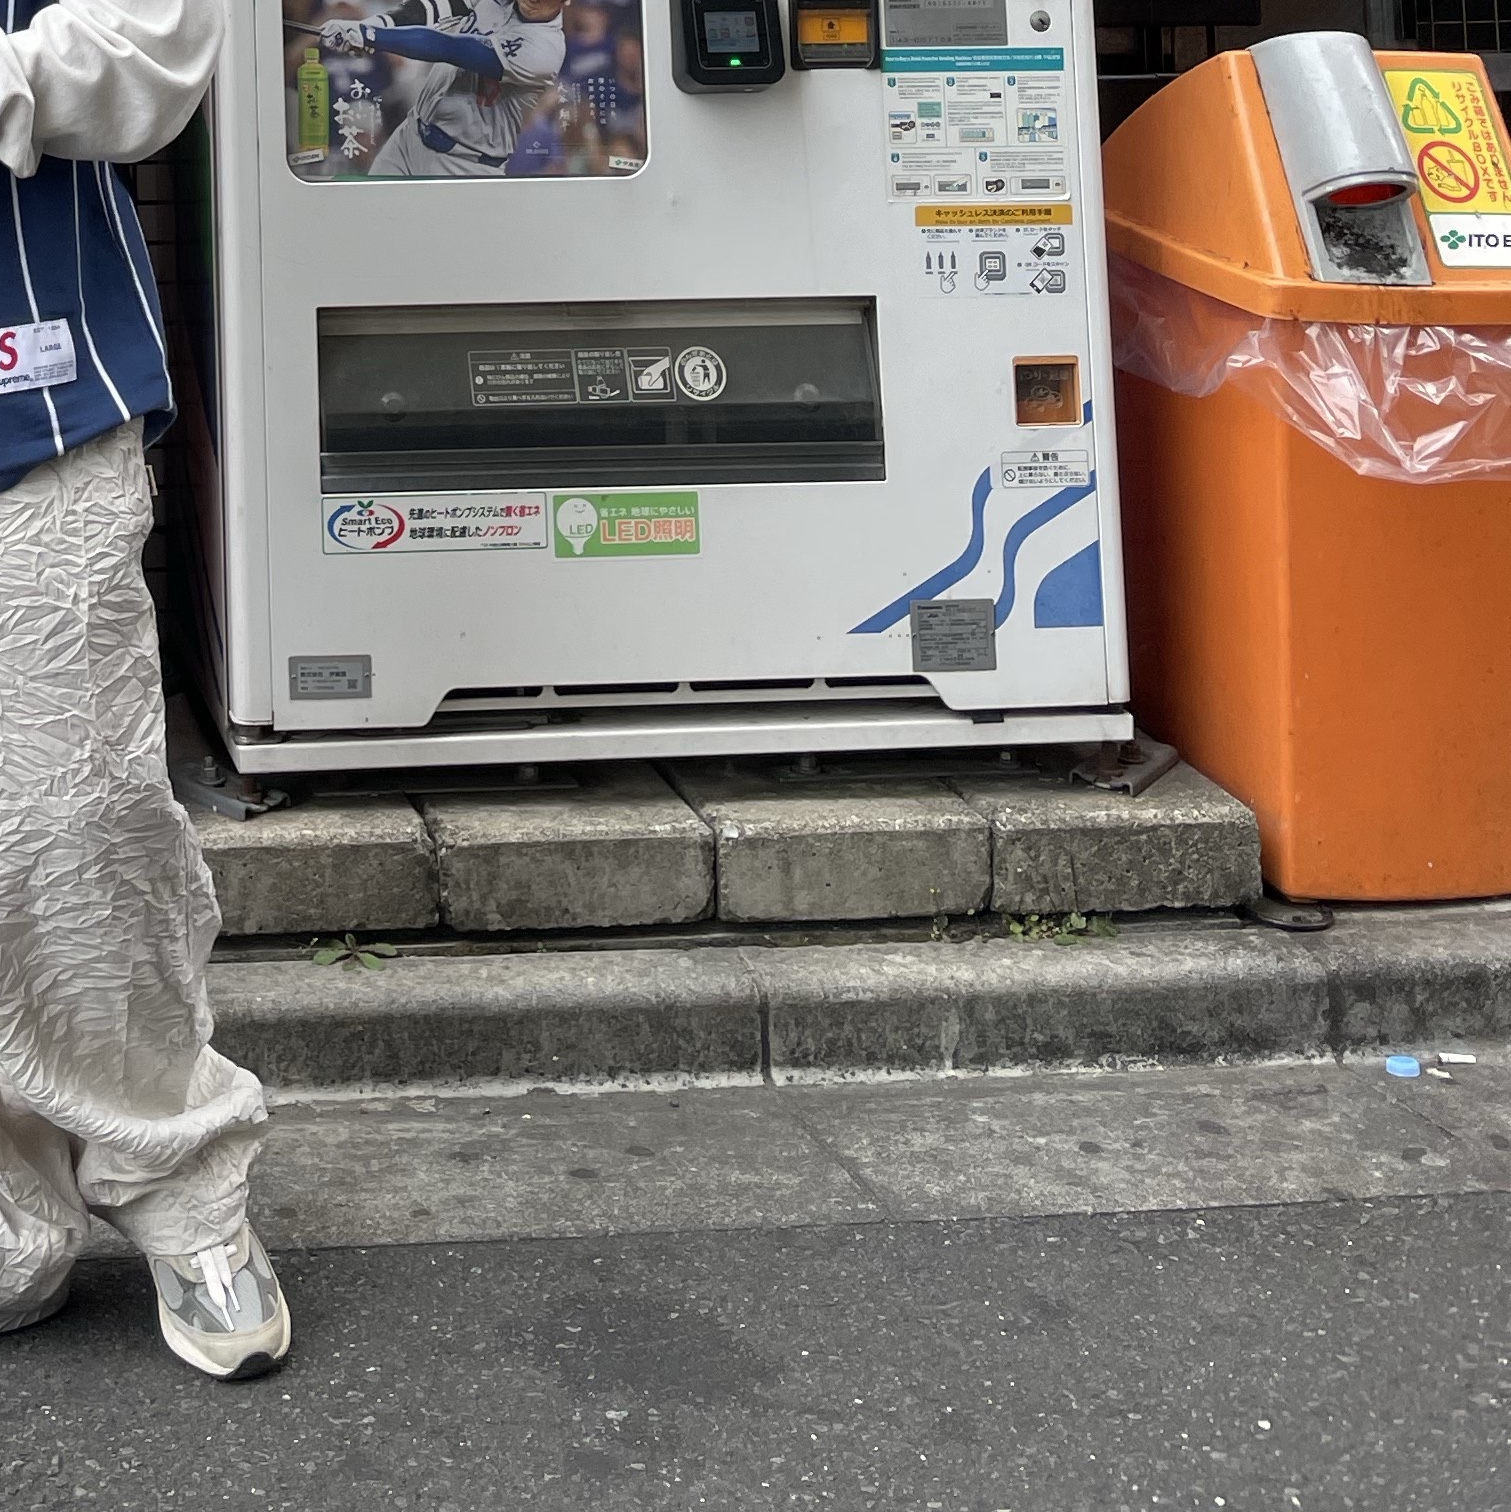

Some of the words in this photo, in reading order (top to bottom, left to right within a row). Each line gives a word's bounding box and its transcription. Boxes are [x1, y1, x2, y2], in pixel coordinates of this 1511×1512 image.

[1452, 80, 1498, 203] リサイクルBOXです
[1468, 233, 1500, 248] ITO
[39, 343, 62, 353] LARGE
[408, 504, 541, 522] 先進のヒートポンプシステムで賢く省エネ
[600, 506, 627, 517] 省エネ
[630, 505, 696, 517] 地球にやさしい
[340, 516, 373, 526] Smart
[375, 516, 394, 526] Eco
[337, 525, 395, 538] ヒートポンプ
[408, 524, 523, 540] 地球環境に配慮したノンフロン
[568, 523, 594, 536] LED
[600, 517, 697, 544] LED照明
